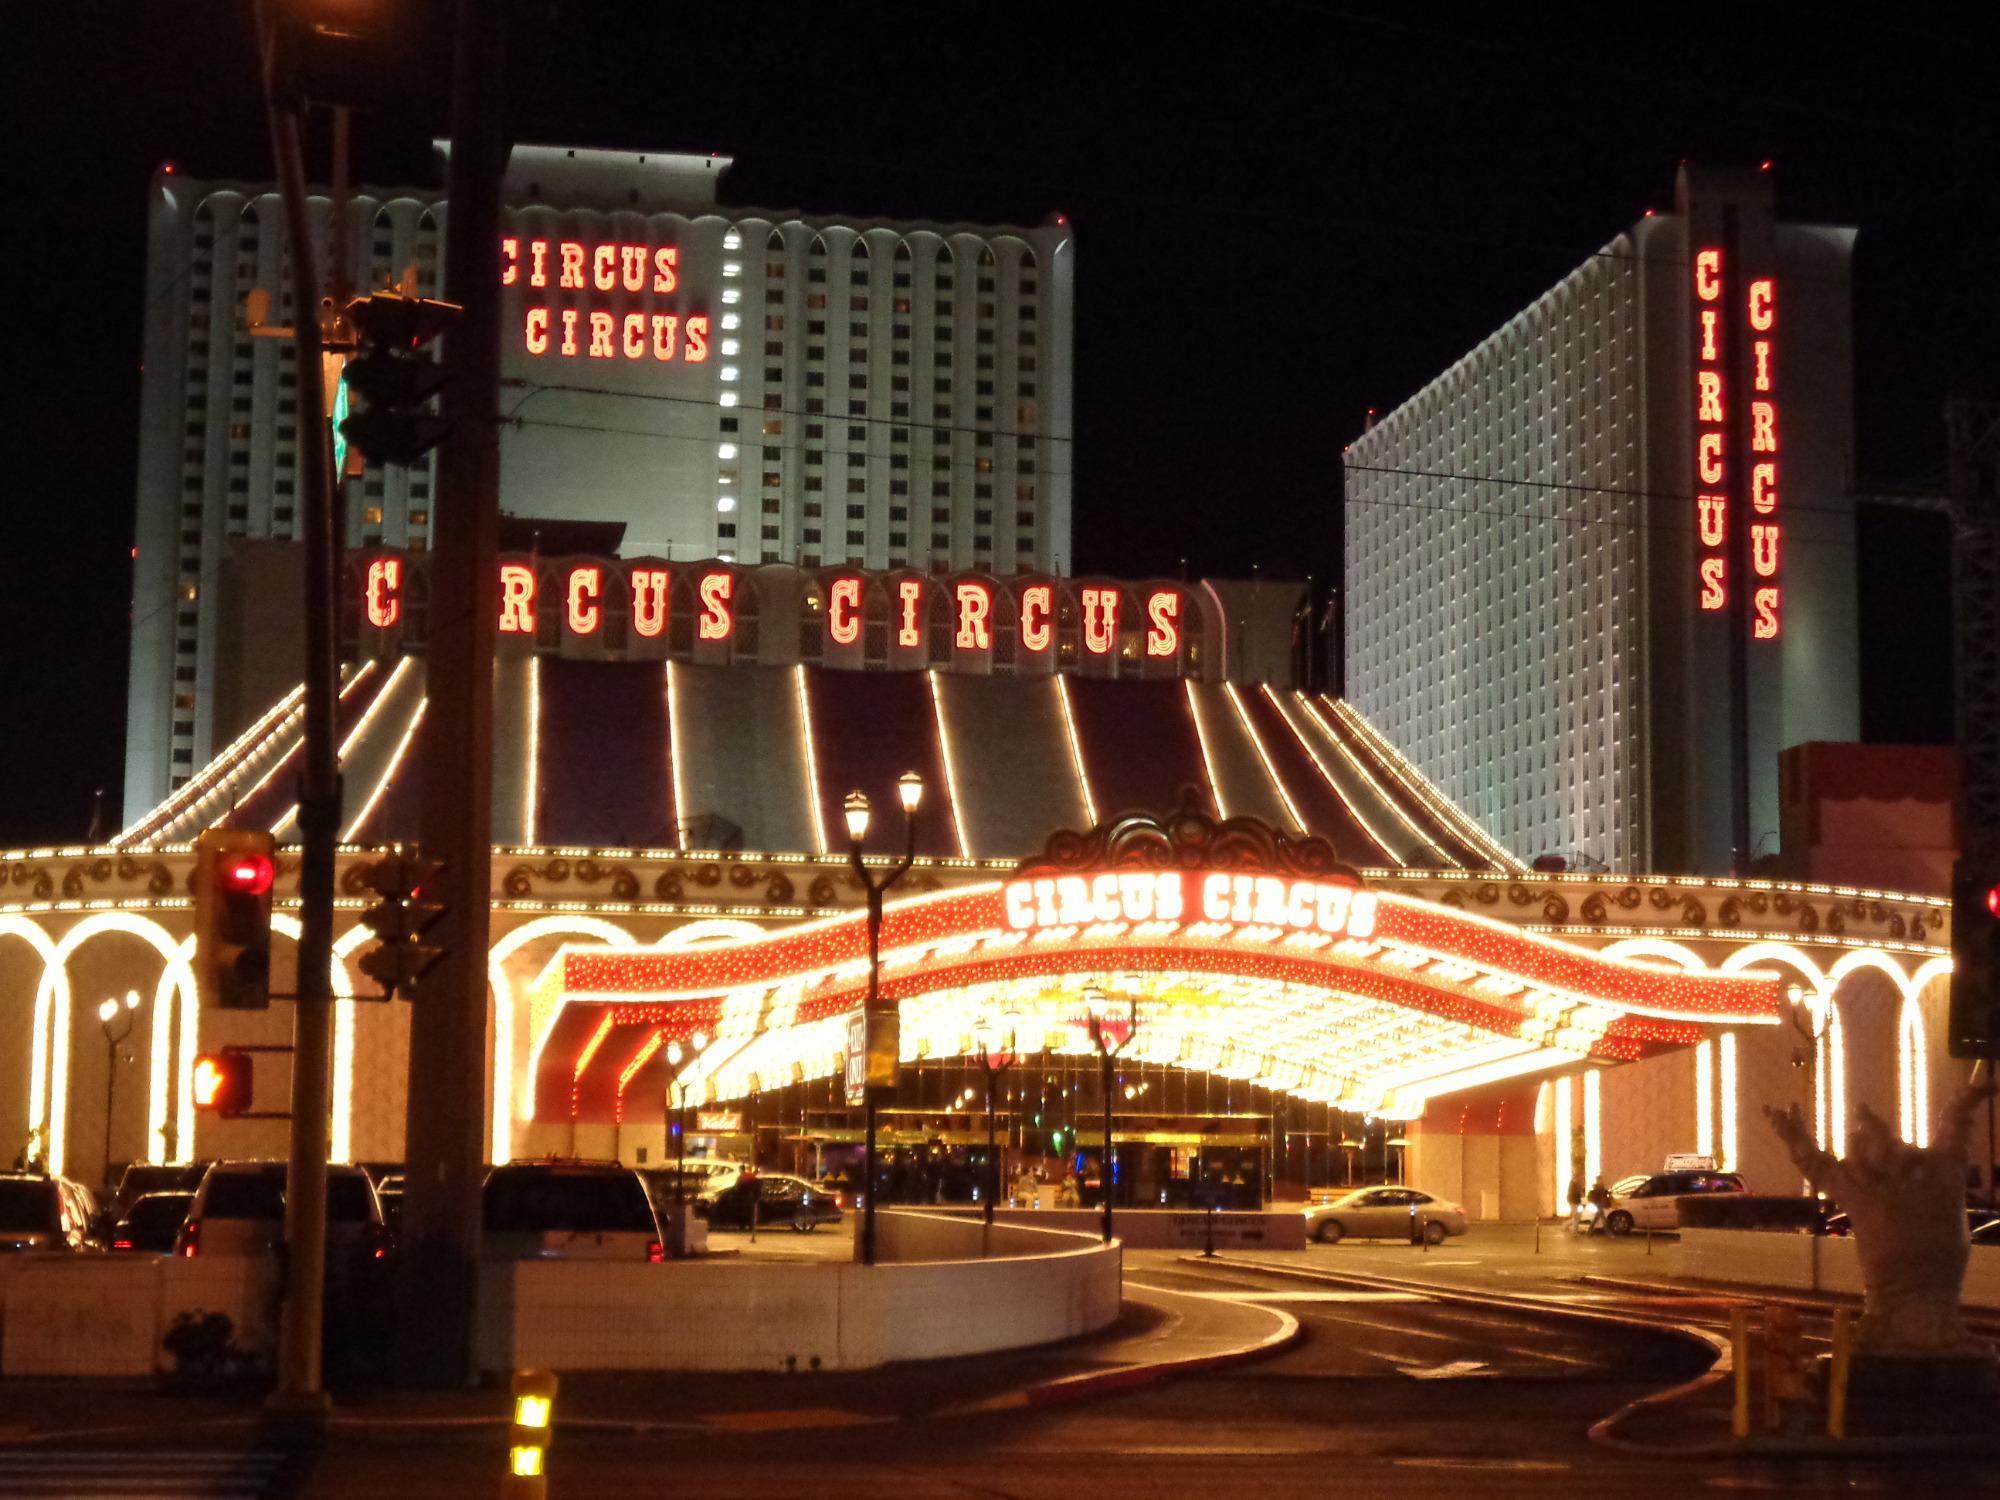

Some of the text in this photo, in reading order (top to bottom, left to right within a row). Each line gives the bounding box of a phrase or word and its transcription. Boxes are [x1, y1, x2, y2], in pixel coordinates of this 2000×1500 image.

[525, 308, 708, 363] CIRCUS
[1696, 250, 1726, 610] CIRCUS
[1748, 280, 1779, 640] CIRCUS
[365, 559, 1178, 656] CRCUS CIRCUS
[1006, 873, 1377, 938] CIRCUS CIRCUS
